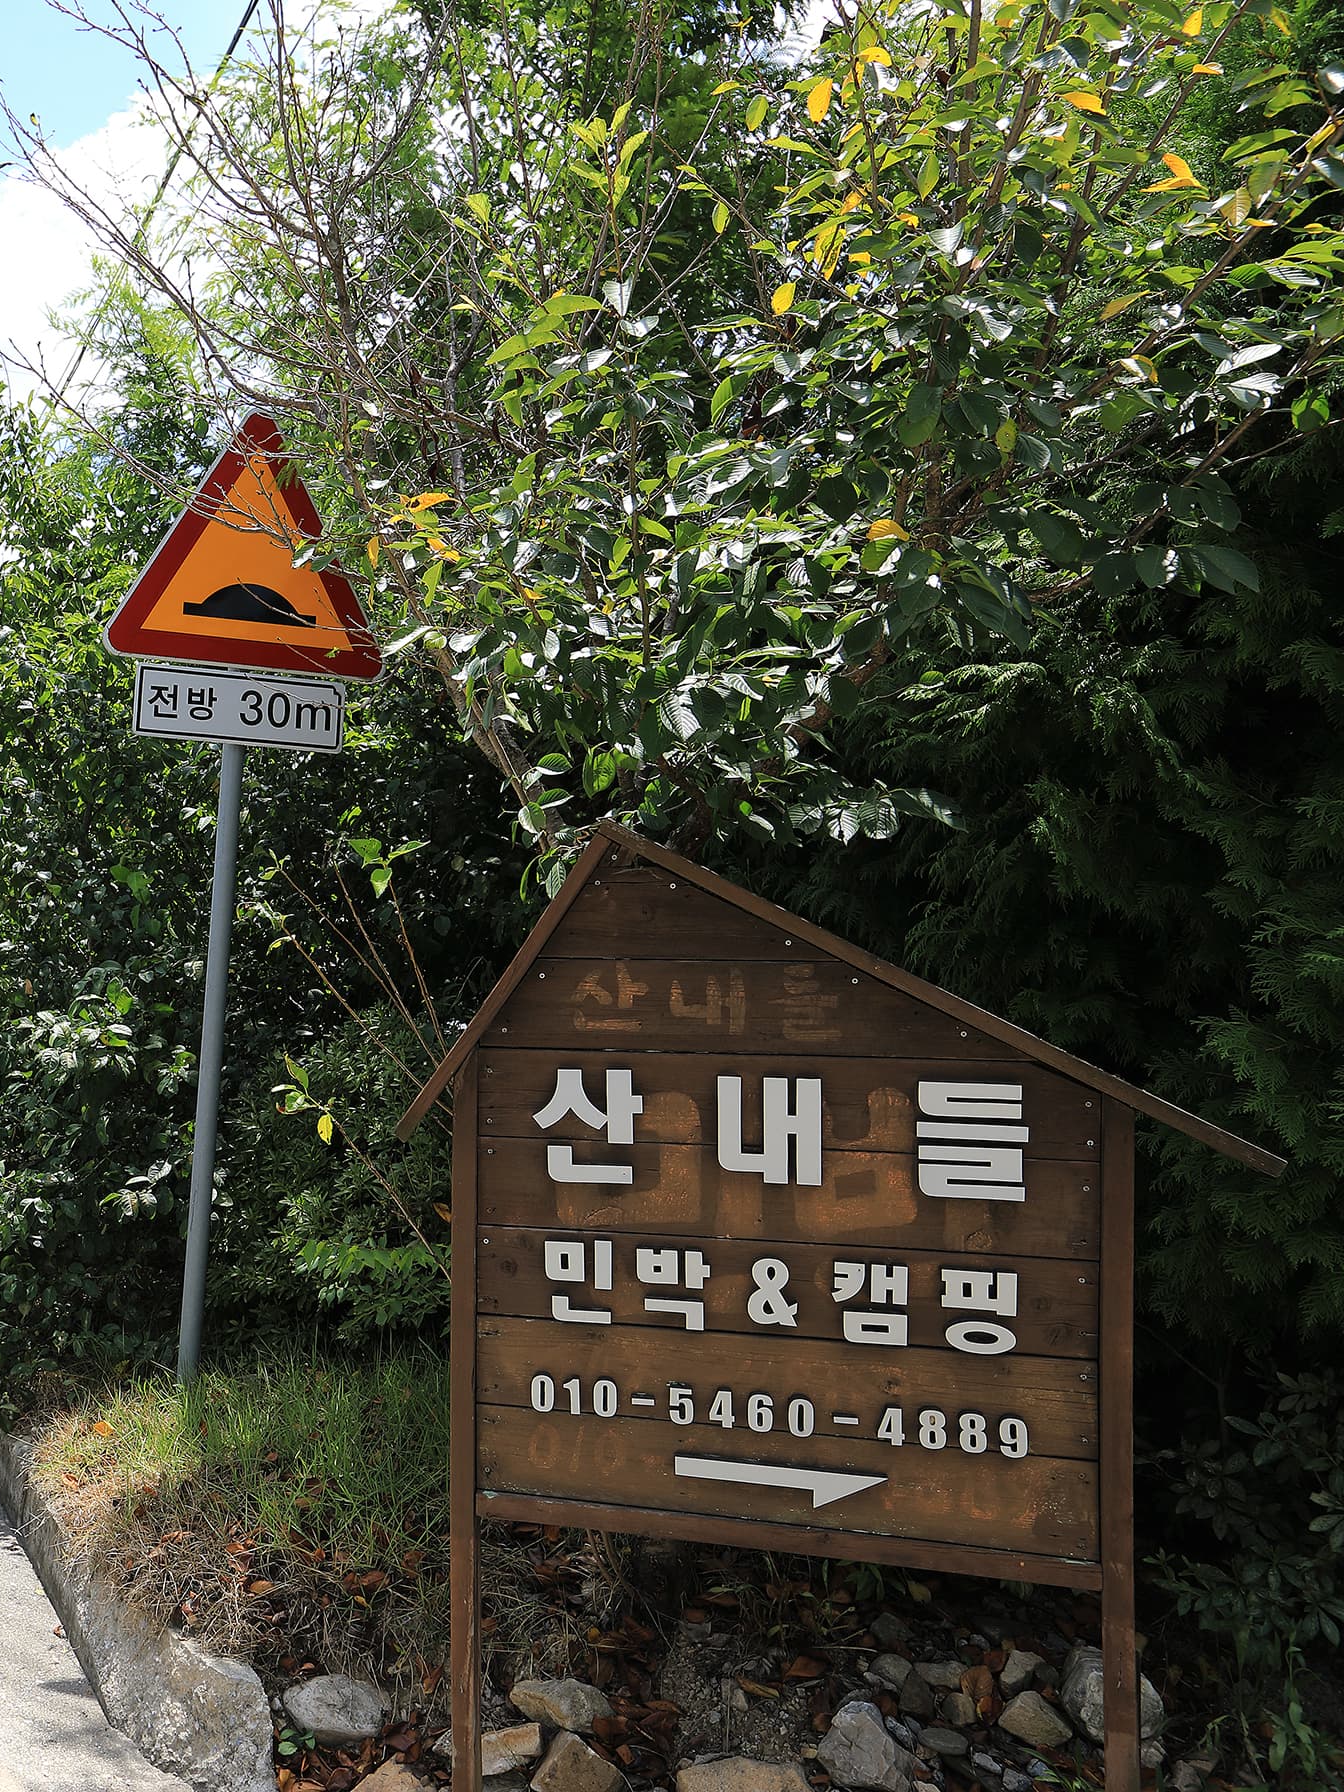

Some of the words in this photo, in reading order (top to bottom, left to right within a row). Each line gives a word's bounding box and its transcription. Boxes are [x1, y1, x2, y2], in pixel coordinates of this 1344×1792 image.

[148, 685, 218, 721] 전방
[239, 690, 332, 731] 30m
[532, 1069, 1030, 1202] 산내들
[544, 1240, 711, 1332] 민박
[747, 1258, 798, 1328] &
[831, 1261, 1018, 1355] 캠핑
[530, 1374, 1030, 1459] 010-5460-4889
